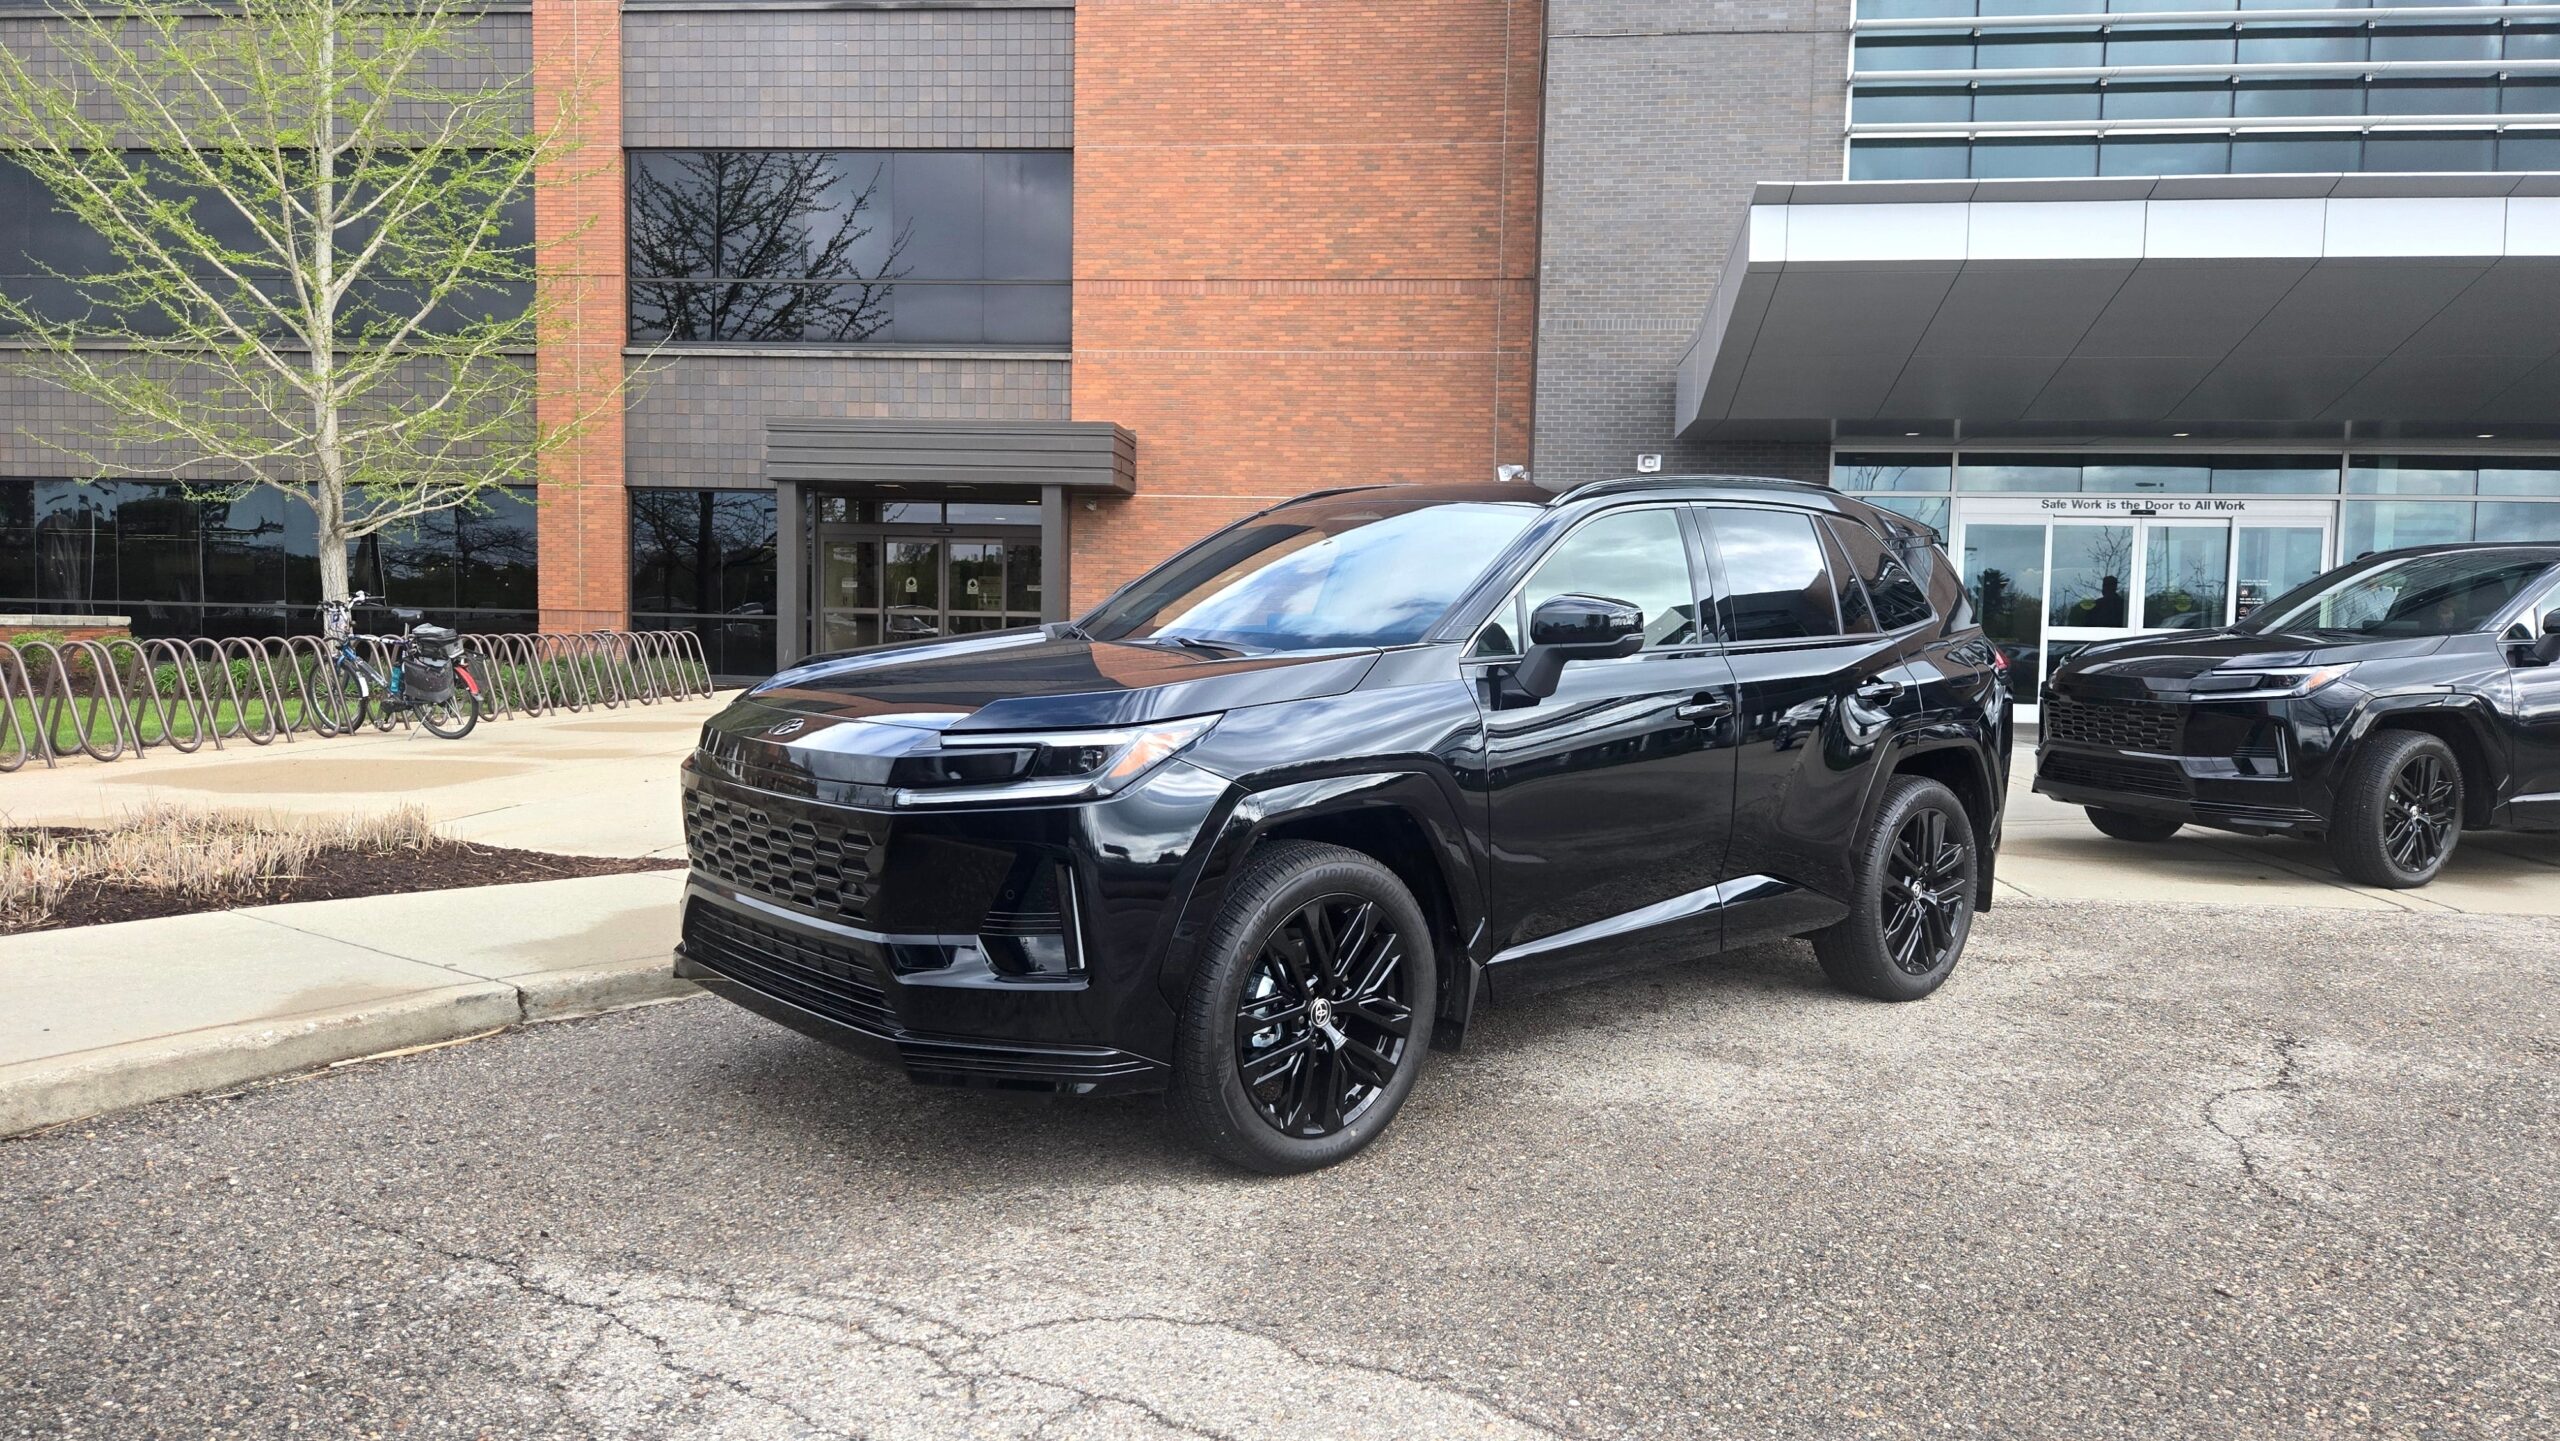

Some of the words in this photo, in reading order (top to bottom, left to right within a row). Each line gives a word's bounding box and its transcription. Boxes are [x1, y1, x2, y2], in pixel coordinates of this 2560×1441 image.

[2041, 499, 2067, 509] Safe
[2071, 499, 2102, 509] Work
[2106, 500, 2117, 510] is
[2120, 500, 2141, 510] the
[2145, 500, 2175, 510] Door
[2178, 501, 2192, 510] to
[2194, 501, 2211, 510] All
[2214, 501, 2246, 511] Work
